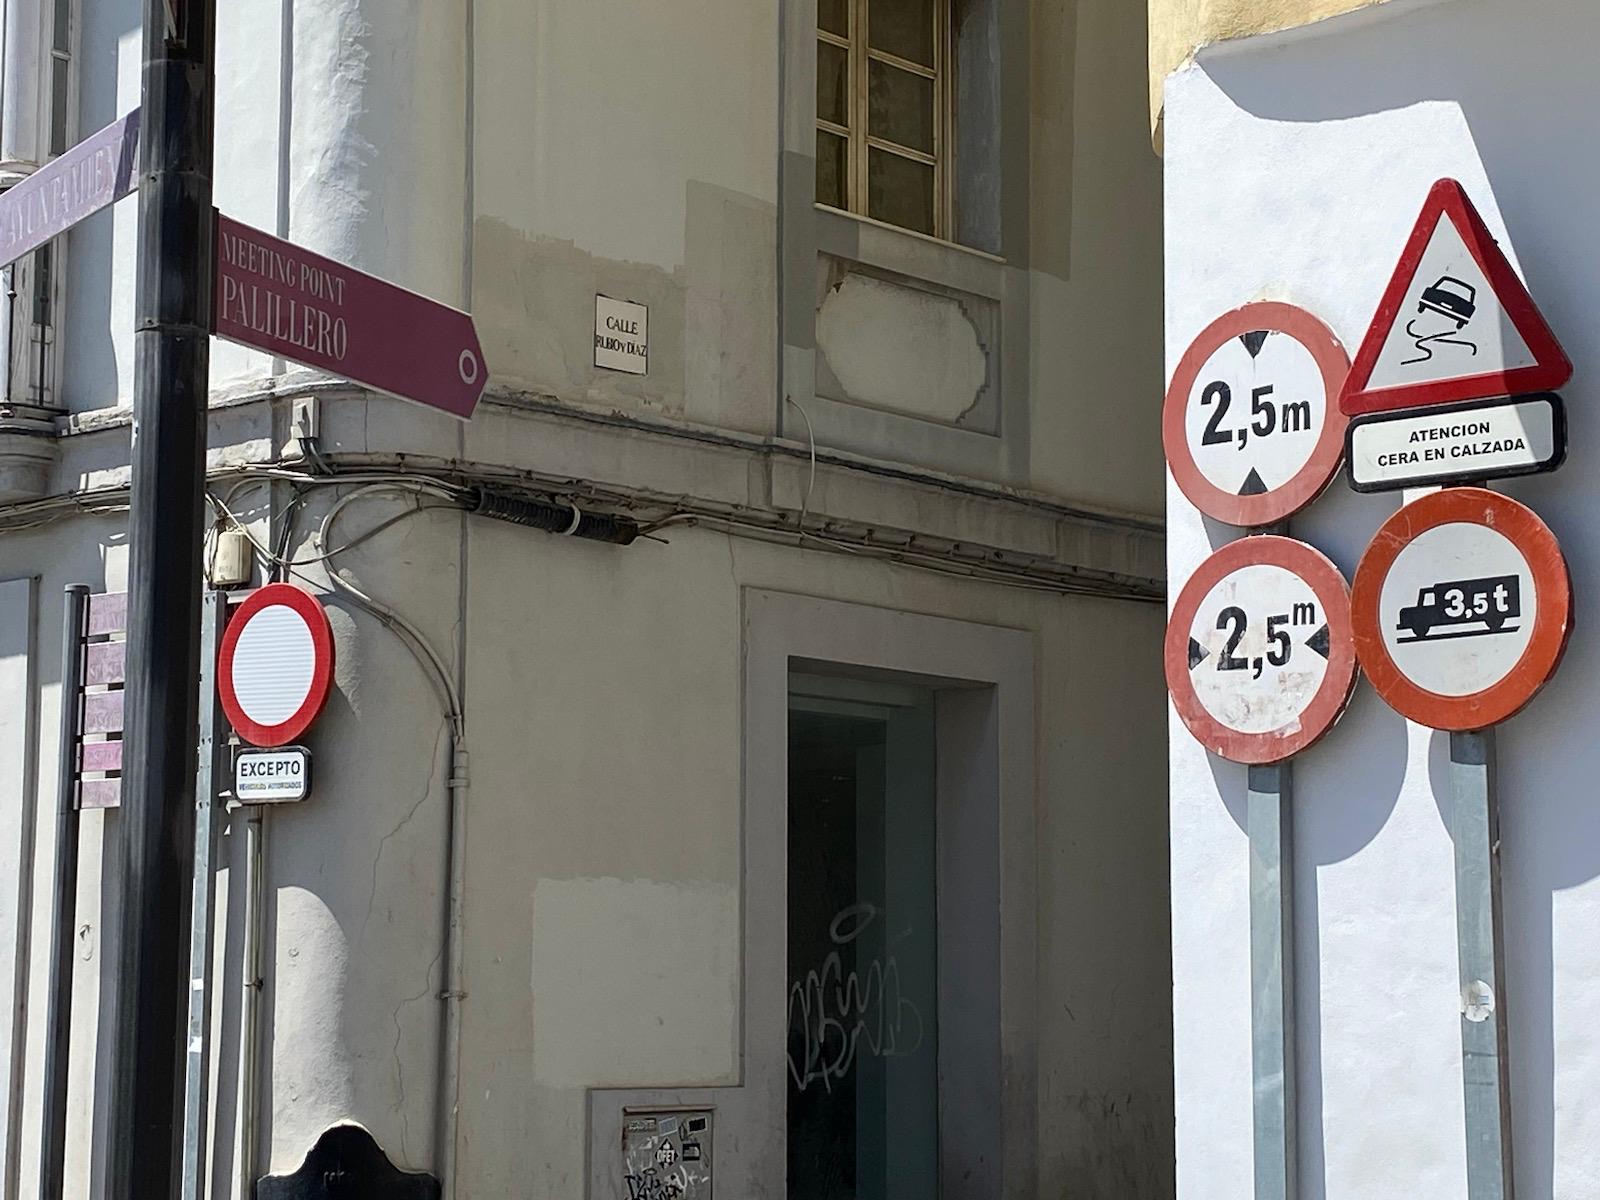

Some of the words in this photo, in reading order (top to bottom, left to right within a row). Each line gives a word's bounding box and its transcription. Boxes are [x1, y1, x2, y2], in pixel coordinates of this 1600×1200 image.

[222, 231, 296, 288] MEETING
[300, 262, 346, 306] POINT
[222, 273, 347, 361] PALILLERO
[606, 316, 638, 335] CALLE
[1409, 421, 1490, 443] ATENCION
[1377, 451, 1419, 467] CERA
[1424, 447, 1445, 461] EN
[1450, 438, 1526, 458] CALZADA
[240, 760, 301, 777] EXCEPTO
